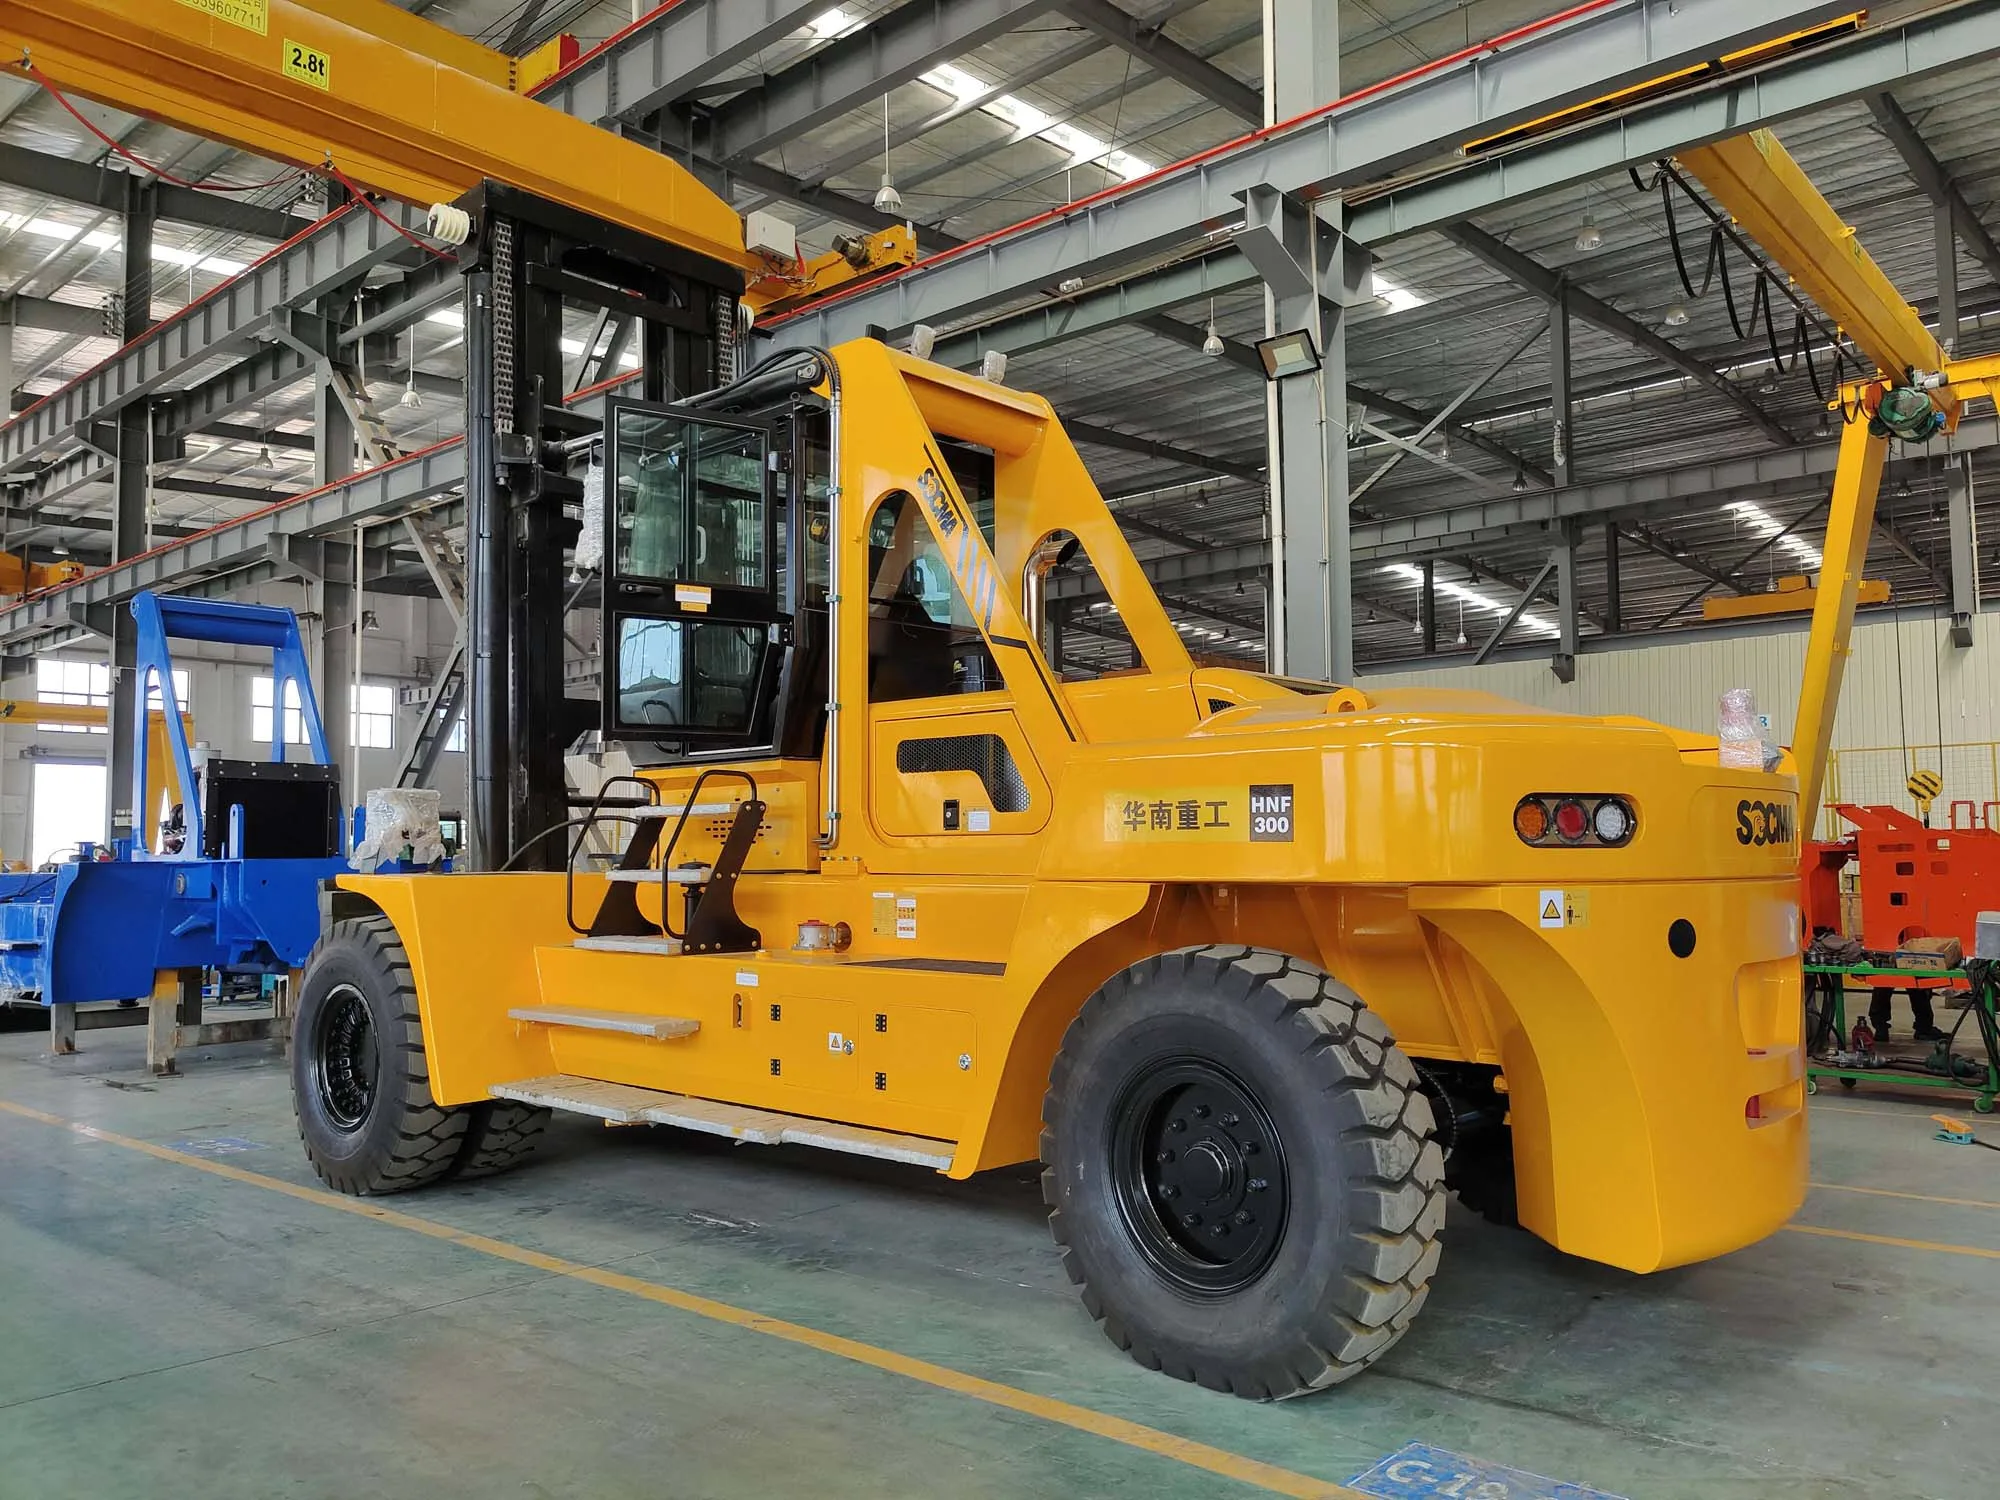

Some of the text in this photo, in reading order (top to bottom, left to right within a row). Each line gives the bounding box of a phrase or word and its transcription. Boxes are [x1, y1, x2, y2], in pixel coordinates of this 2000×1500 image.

[292, 48, 325, 77] 2.8t
[917, 467, 957, 537] SOCMA
[1122, 800, 1230, 832] 华南重工
[1251, 796, 1292, 814] HNF
[1254, 817, 1289, 833] 300
